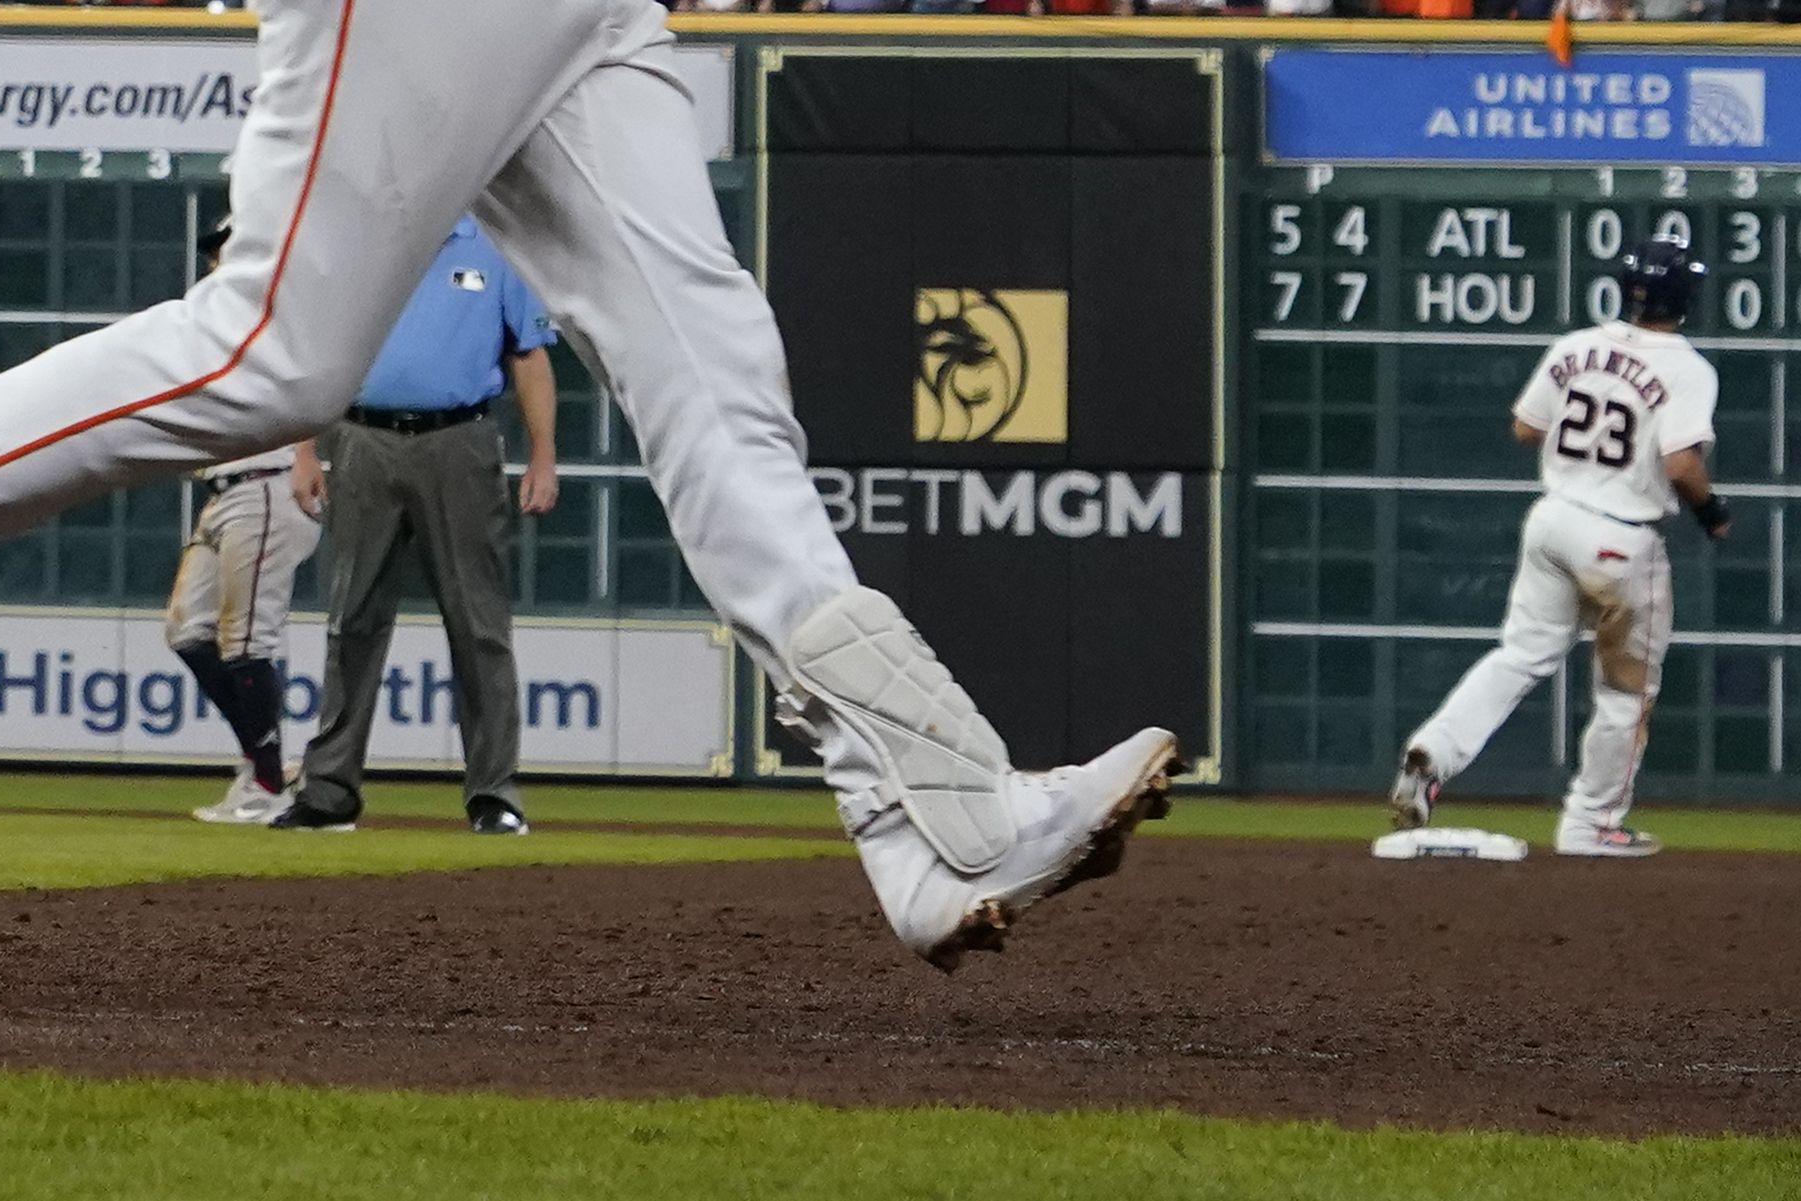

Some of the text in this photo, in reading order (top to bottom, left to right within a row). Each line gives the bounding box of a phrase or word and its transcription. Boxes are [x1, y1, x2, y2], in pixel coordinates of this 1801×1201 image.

[1474, 72, 1672, 105] UNITED
[1424, 106, 1672, 140] AIRLINES
[20, 147, 172, 180] 1 2 3
[1306, 164, 1336, 195] P
[1597, 166, 1759, 200] 1 2 3
[1425, 207, 1527, 259] ATL
[1586, 208, 1623, 261] 0
[1728, 211, 1763, 264] 3
[1415, 273, 1537, 325] HOU
[1586, 275, 1623, 326] 0
[1726, 278, 1763, 331] 0
[1557, 388, 1636, 470] 23
[807, 467, 1183, 539] BETMGM
